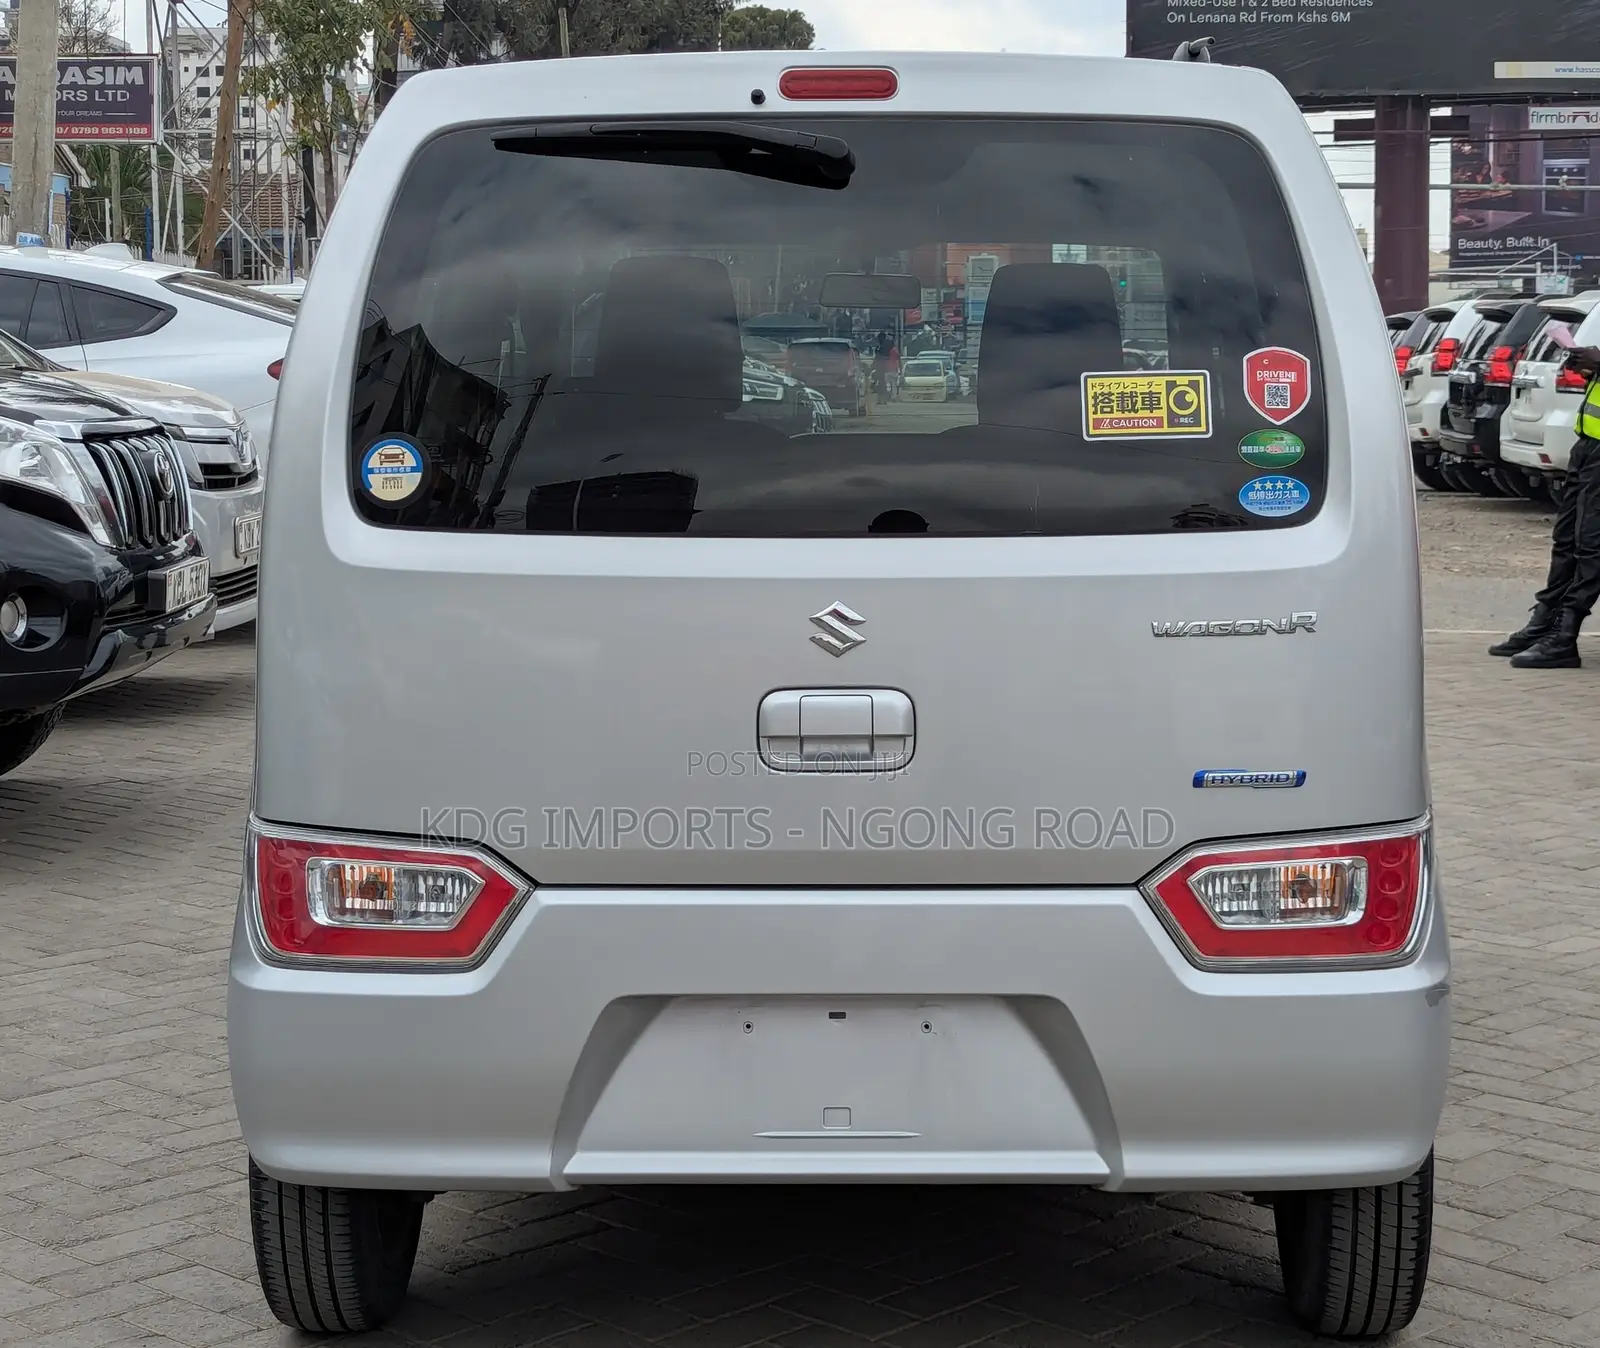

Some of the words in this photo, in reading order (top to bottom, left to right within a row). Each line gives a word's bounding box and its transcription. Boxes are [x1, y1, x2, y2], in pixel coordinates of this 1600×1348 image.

[1167, 12, 1185, 23] On
[1189, 12, 1236, 23] Lenana
[1239, 11, 1256, 23] Rd
[1260, 12, 1293, 23] From
[1297, 10, 1328, 23] Kshs
[1331, 12, 1351, 23] 6M
[56, 66, 144, 85] ASIM
[95, 89, 129, 101] LTD
[1092, 390, 1163, 415] 搭載車
[1112, 418, 1157, 428] CAUTION
[1211, 772, 1291, 785] HYBRID
